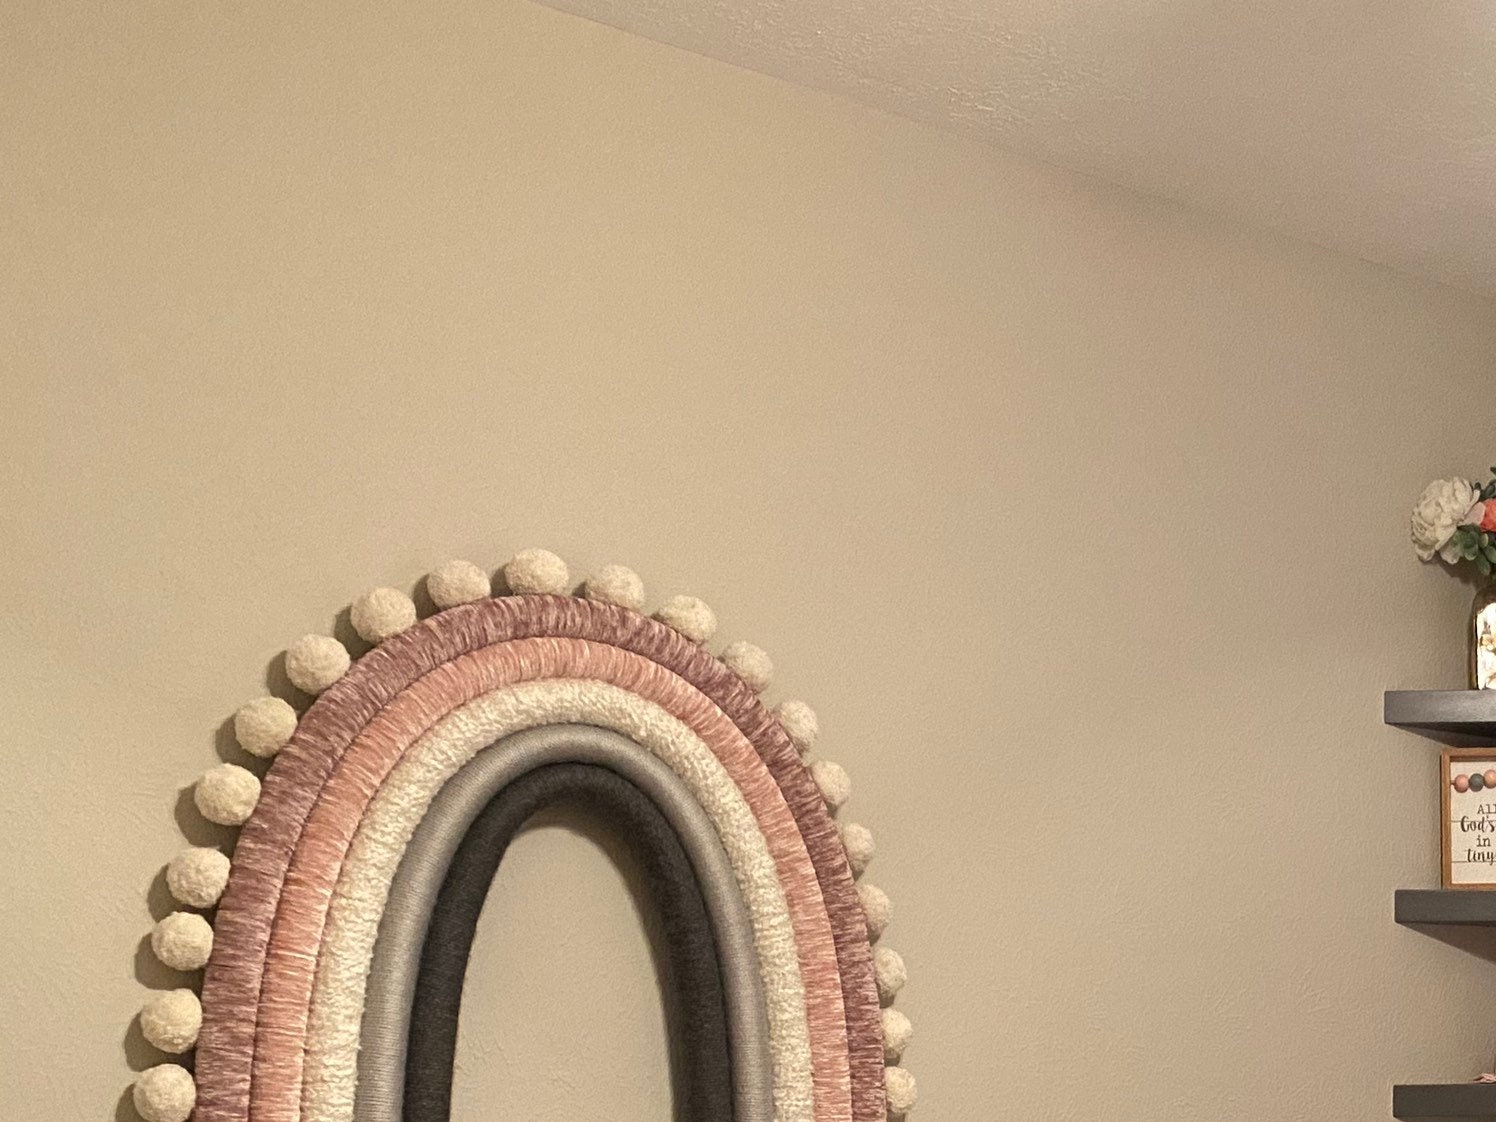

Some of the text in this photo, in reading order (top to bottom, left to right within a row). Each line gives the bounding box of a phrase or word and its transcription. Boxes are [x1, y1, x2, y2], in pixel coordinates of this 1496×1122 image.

[1460, 815, 1496, 833] God's
[1476, 834, 1491, 847] in
[1465, 848, 1496, 866] tiny
